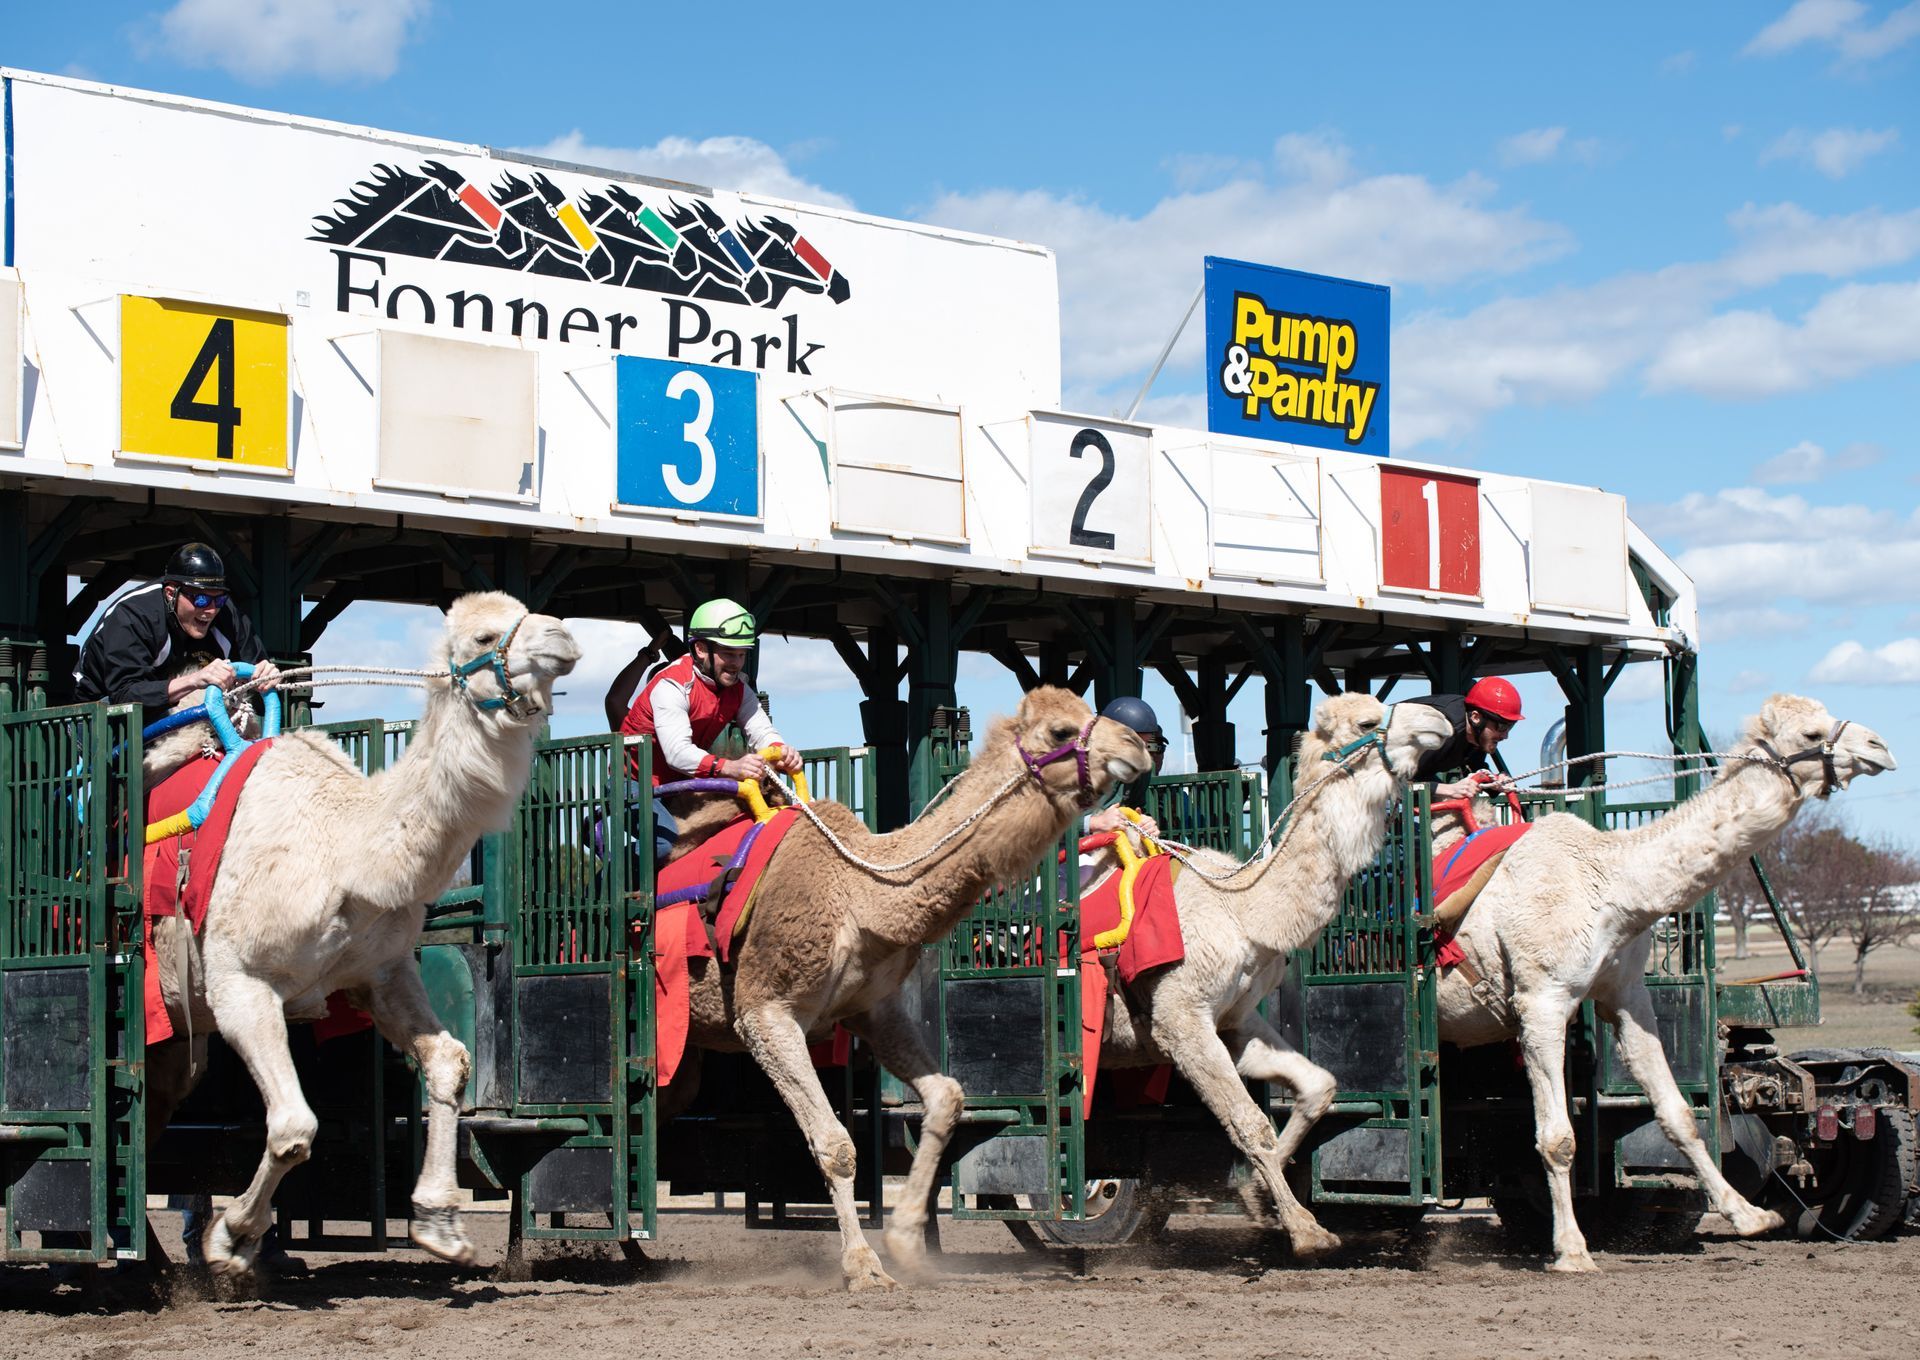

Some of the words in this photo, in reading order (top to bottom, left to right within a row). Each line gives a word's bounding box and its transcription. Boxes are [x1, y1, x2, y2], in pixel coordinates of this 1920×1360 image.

[446, 187, 462, 204] 4
[545, 202, 559, 219] 6
[626, 211, 641, 228] 2
[706, 227, 720, 244] 8
[329, 249, 638, 350] Fonner
[661, 297, 825, 376] Park
[1234, 296, 1356, 382] Pump
[170, 317, 242, 460] 4
[1223, 345, 1254, 395] &
[1246, 357, 1376, 440] Pantry
[661, 370, 717, 504] 3
[1069, 427, 1116, 551] 2
[1421, 480, 1441, 590] 1
